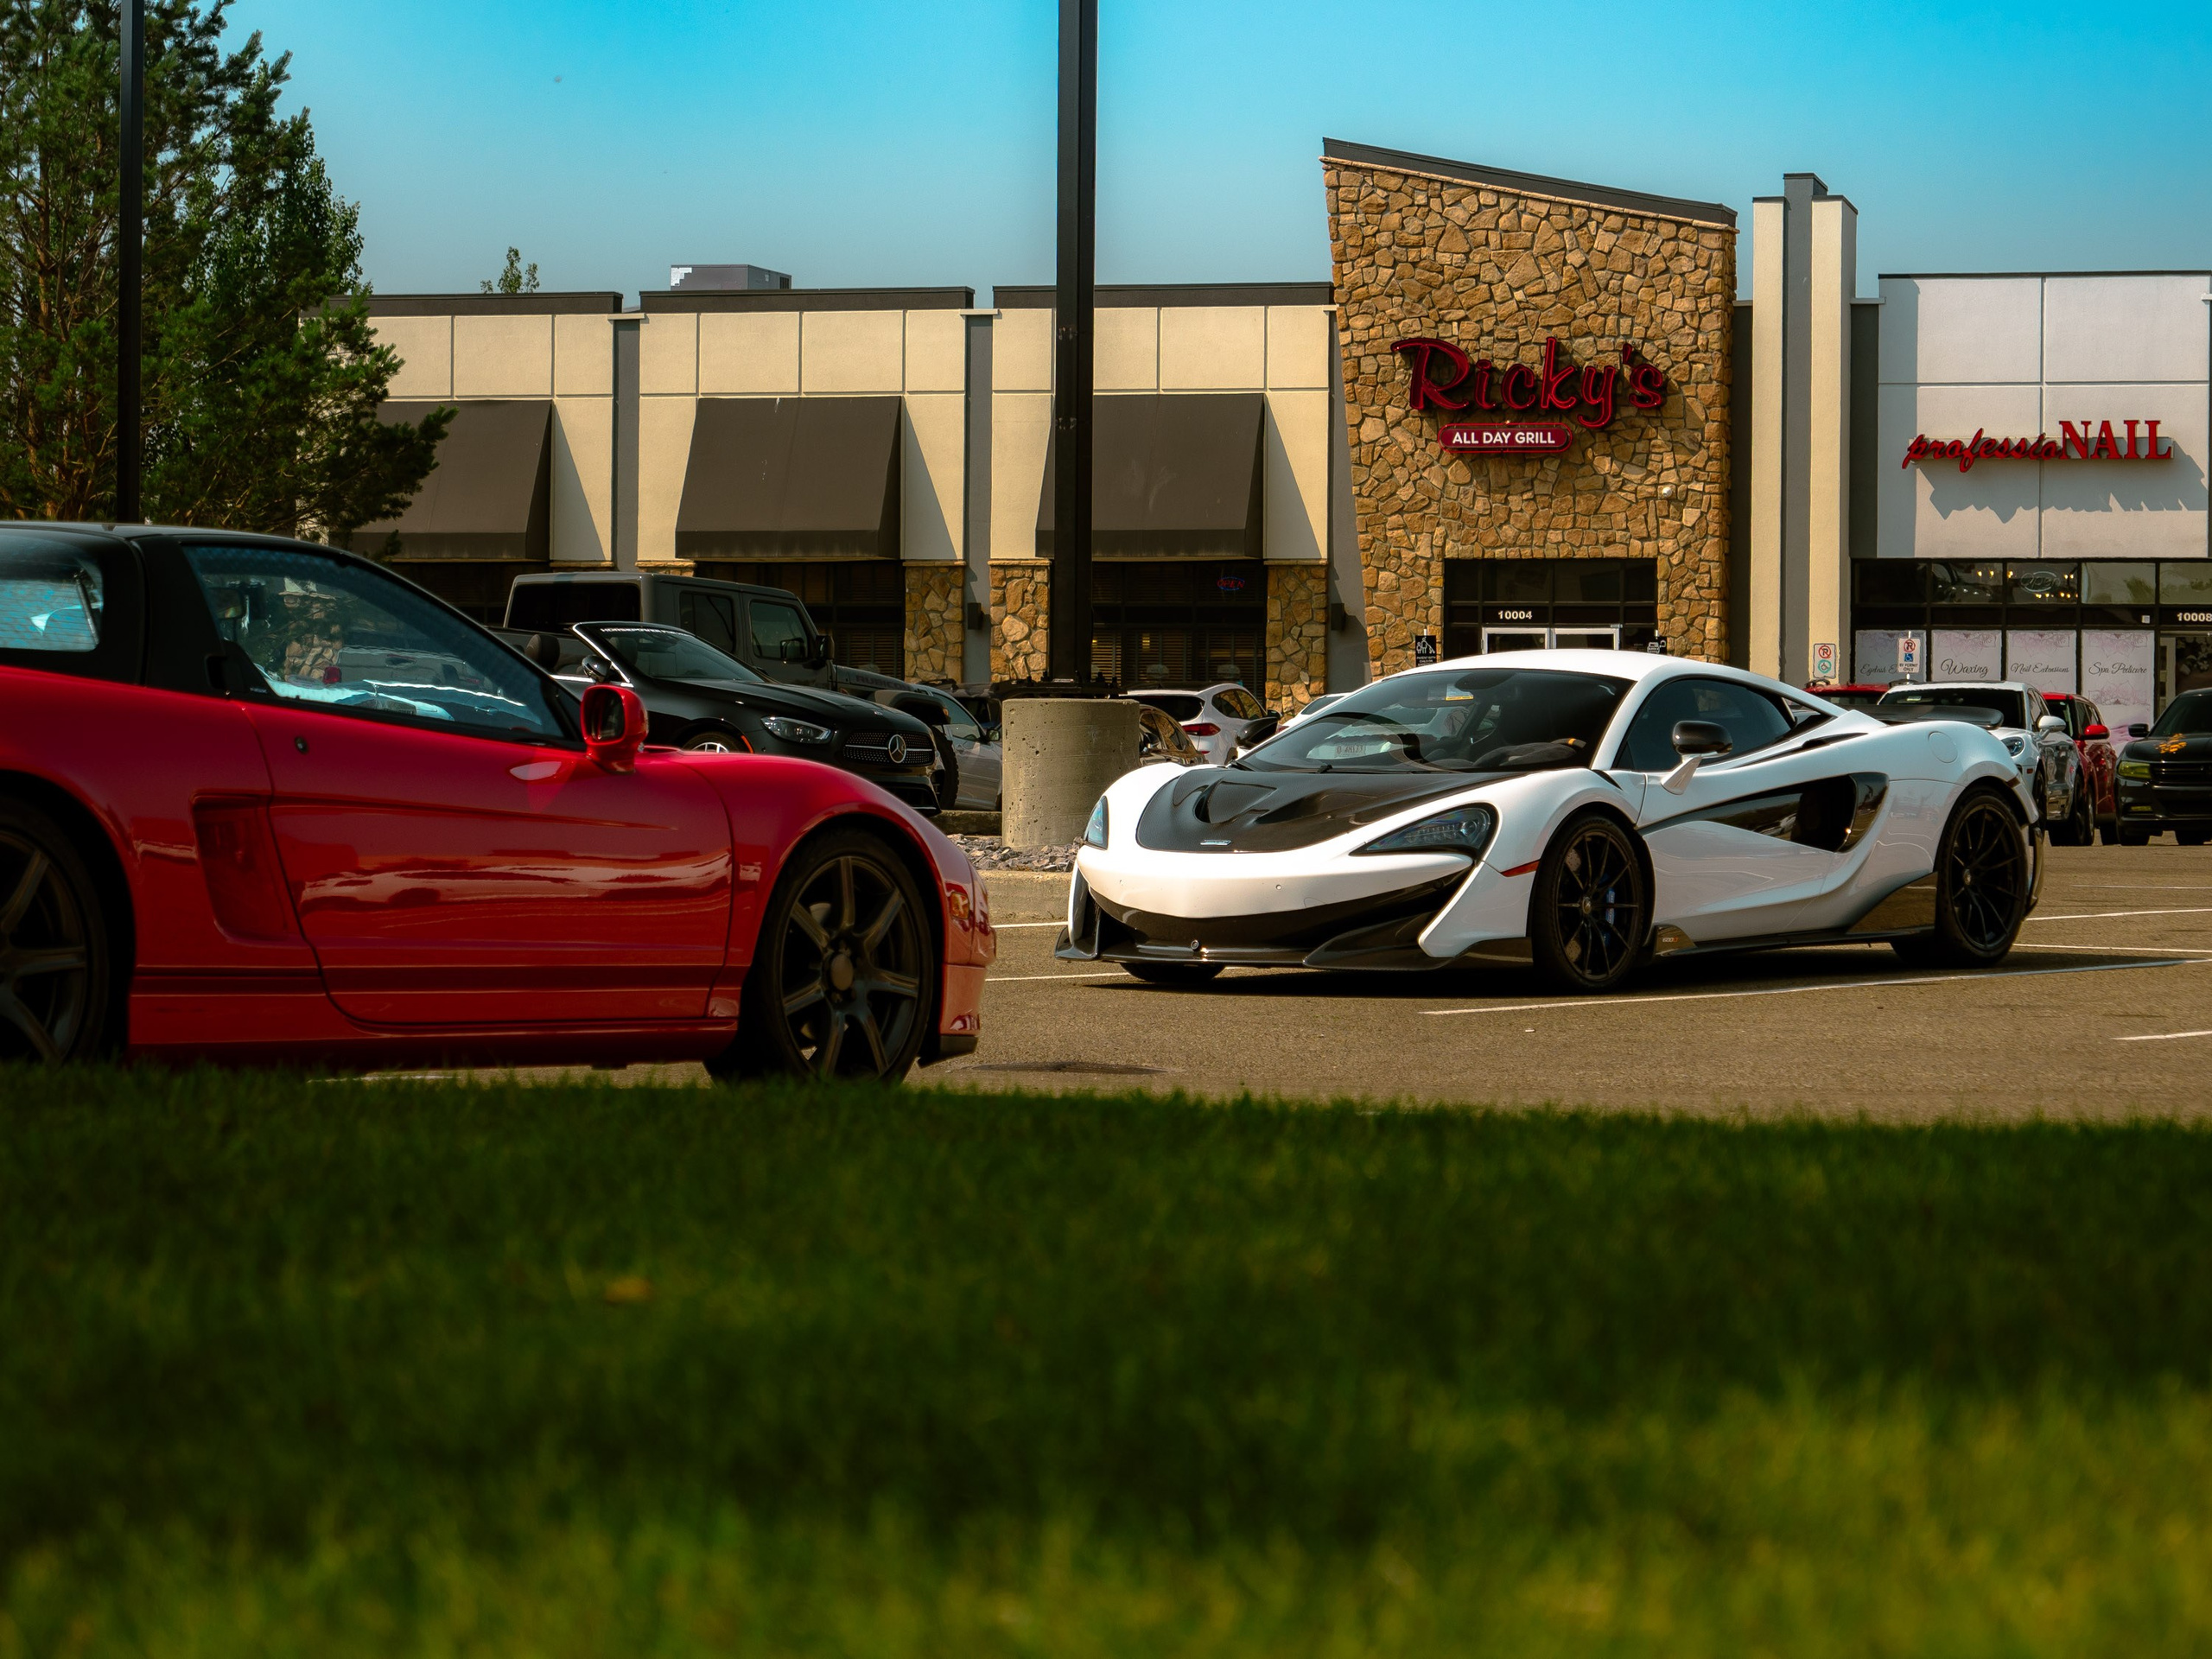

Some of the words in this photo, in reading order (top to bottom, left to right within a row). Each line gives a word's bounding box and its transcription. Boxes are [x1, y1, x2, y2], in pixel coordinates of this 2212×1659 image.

[1390, 337, 1668, 429] Ricky's
[1452, 432, 1479, 444] ALL
[1483, 432, 1510, 444] DAY
[1515, 432, 1555, 444] GRILL
[1497, 610, 1533, 620] 10004
[2177, 612, 2212, 622] 10008
[1940, 658, 1988, 678] Waxing
[2011, 663, 2031, 674] Nail
[2032, 663, 2069, 674] Extensions
[2088, 662, 2109, 677] Spa
[2111, 662, 2148, 674] Pedicure
